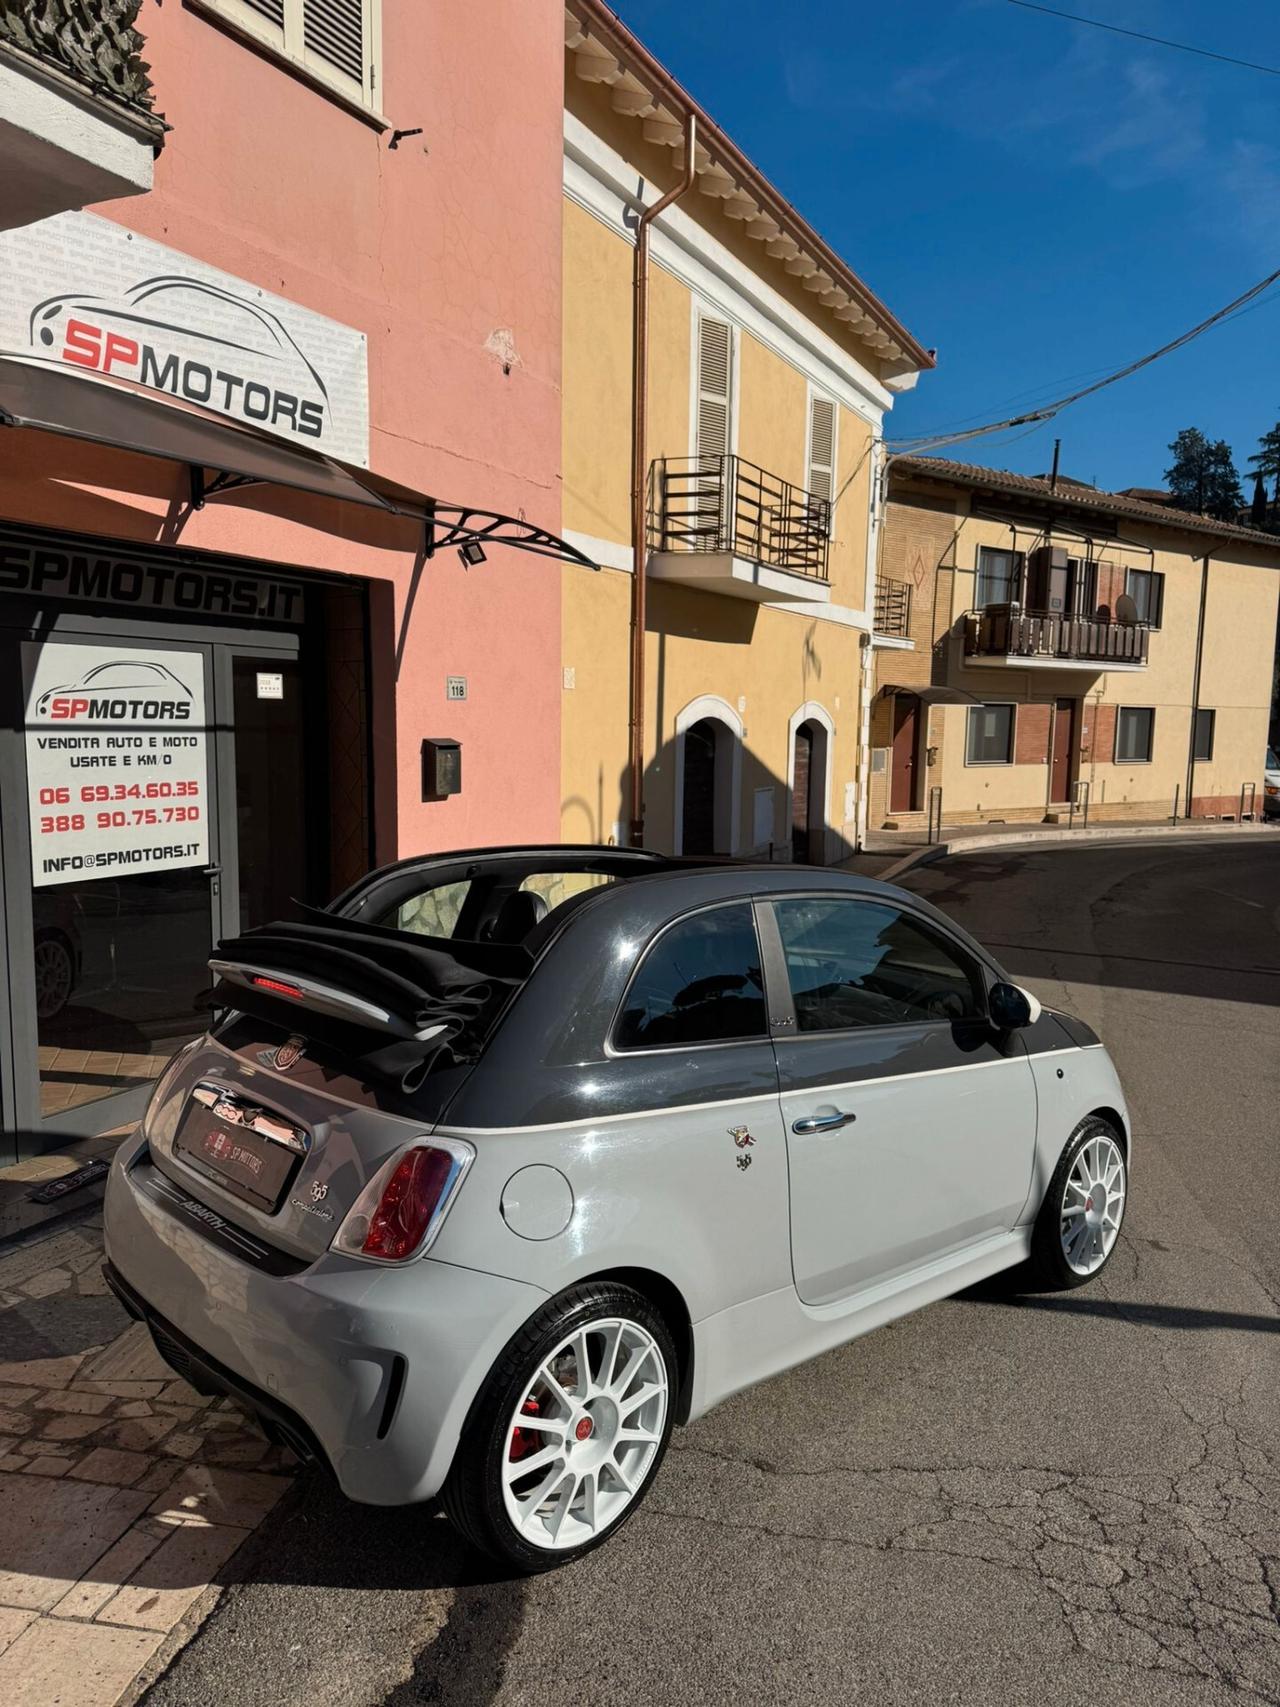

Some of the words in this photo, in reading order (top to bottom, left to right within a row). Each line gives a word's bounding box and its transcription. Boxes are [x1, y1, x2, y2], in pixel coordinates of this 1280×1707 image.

[62, 318, 324, 438] SPMOTORS
[0, 546, 301, 619] SPMOTORS.IT
[451, 685, 464, 696] 118
[51, 698, 191, 720] SPMOTORS
[37, 737, 100, 750] VENDITA
[106, 736, 143, 749] AUTO
[149, 737, 157, 749] E
[163, 736, 198, 748] MOTO
[70, 755, 117, 768] USATE
[123, 755, 131, 767] E
[39, 787, 70, 805] 06
[80, 781, 199, 803] 69.34.60.35
[40, 814, 85, 834] 388
[97, 806, 199, 829] 90.75.730
[43, 843, 200, 874] INFO@SPMOTORS.IT
[310, 1180, 329, 1202] 595
[180, 1200, 228, 1230] ABARTH
